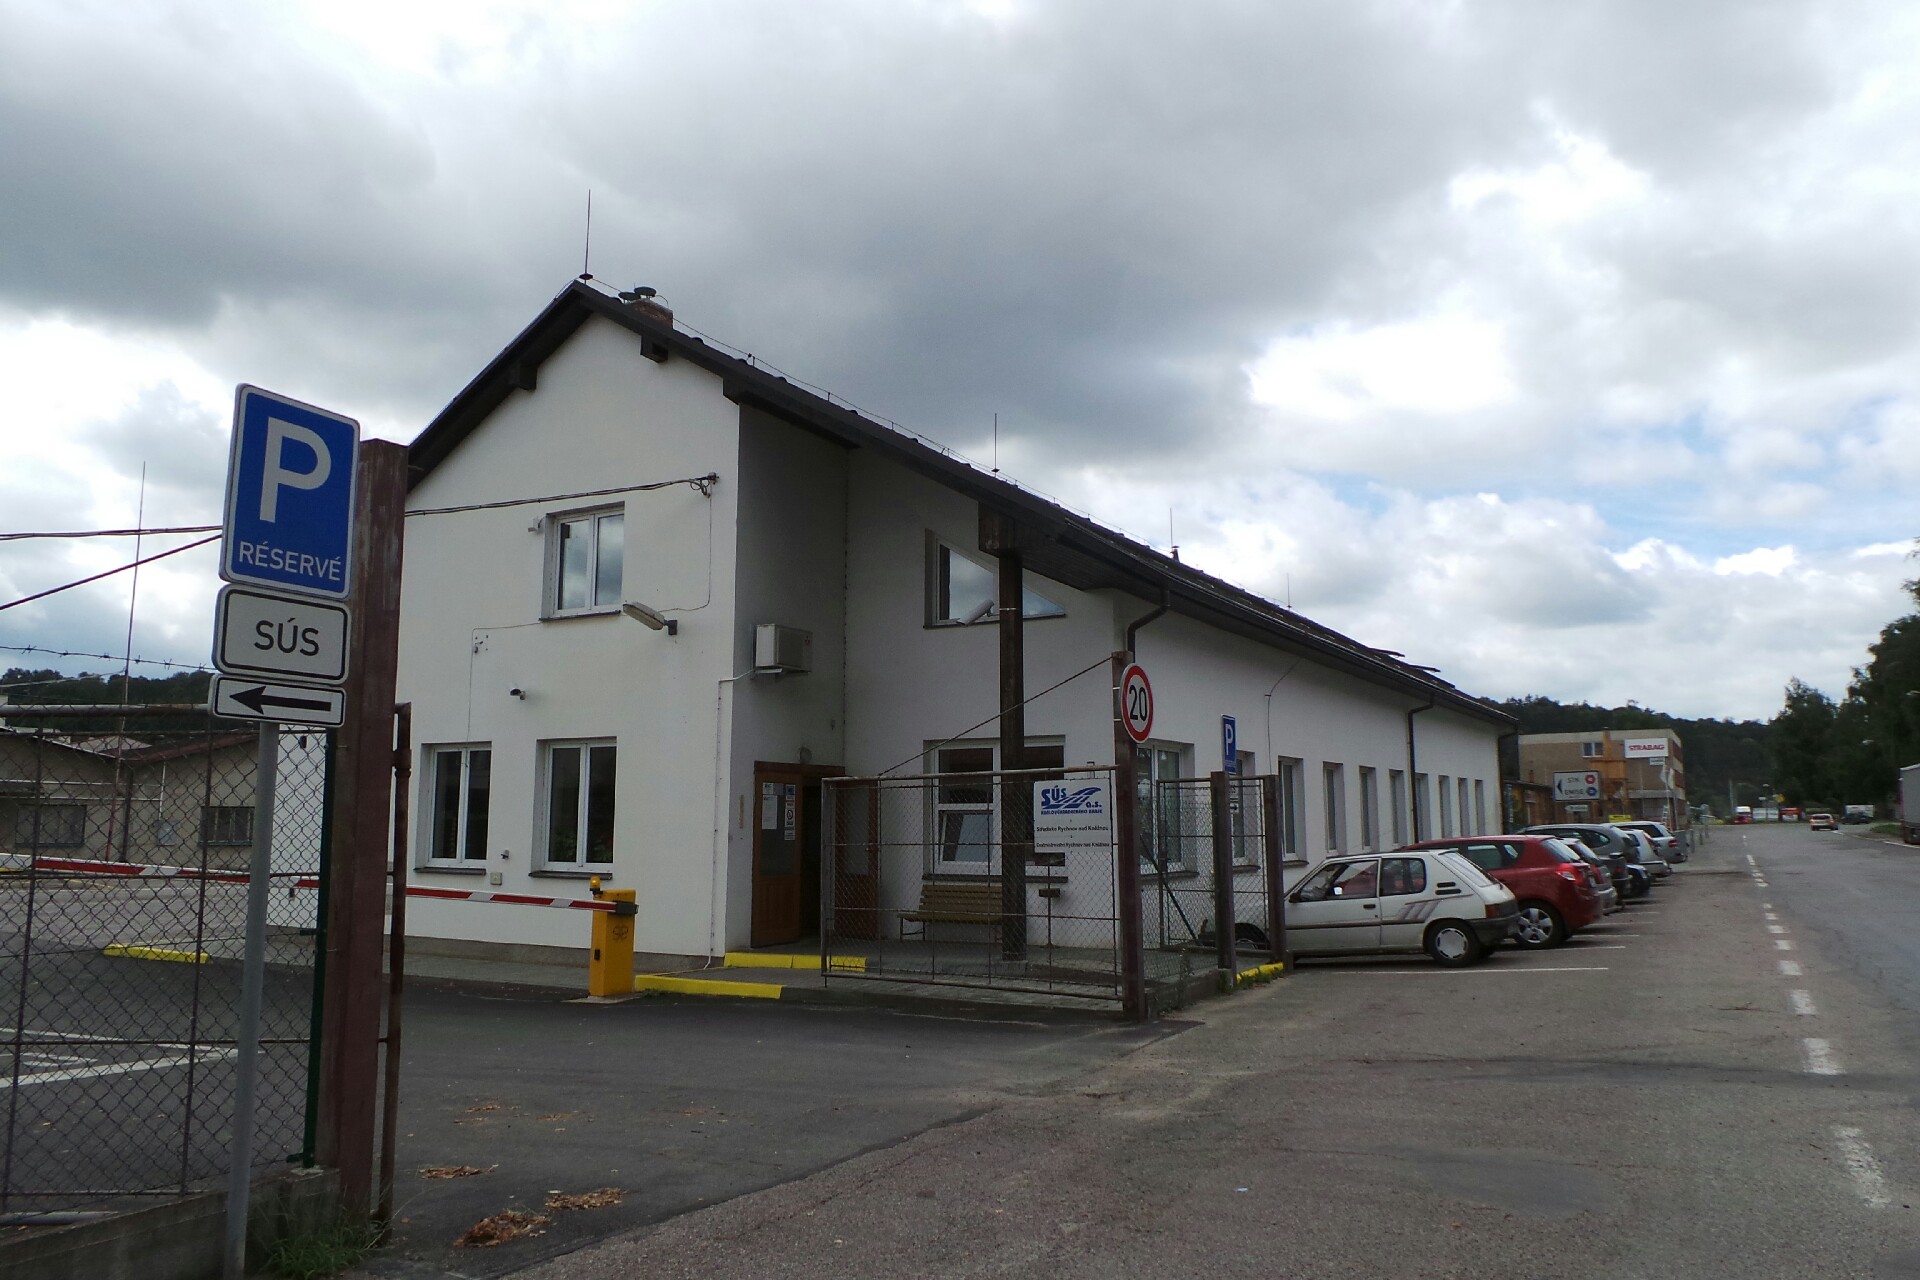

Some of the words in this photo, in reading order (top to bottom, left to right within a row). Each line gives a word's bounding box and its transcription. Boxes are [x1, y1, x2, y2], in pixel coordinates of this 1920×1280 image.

[260, 416, 332, 523] P
[239, 541, 341, 581] RÉSERVÉ
[254, 618, 320, 657] SÚS
[1129, 685, 1148, 722] 20
[1225, 724, 1234, 756] P
[1041, 785, 1067, 807] SÚS
